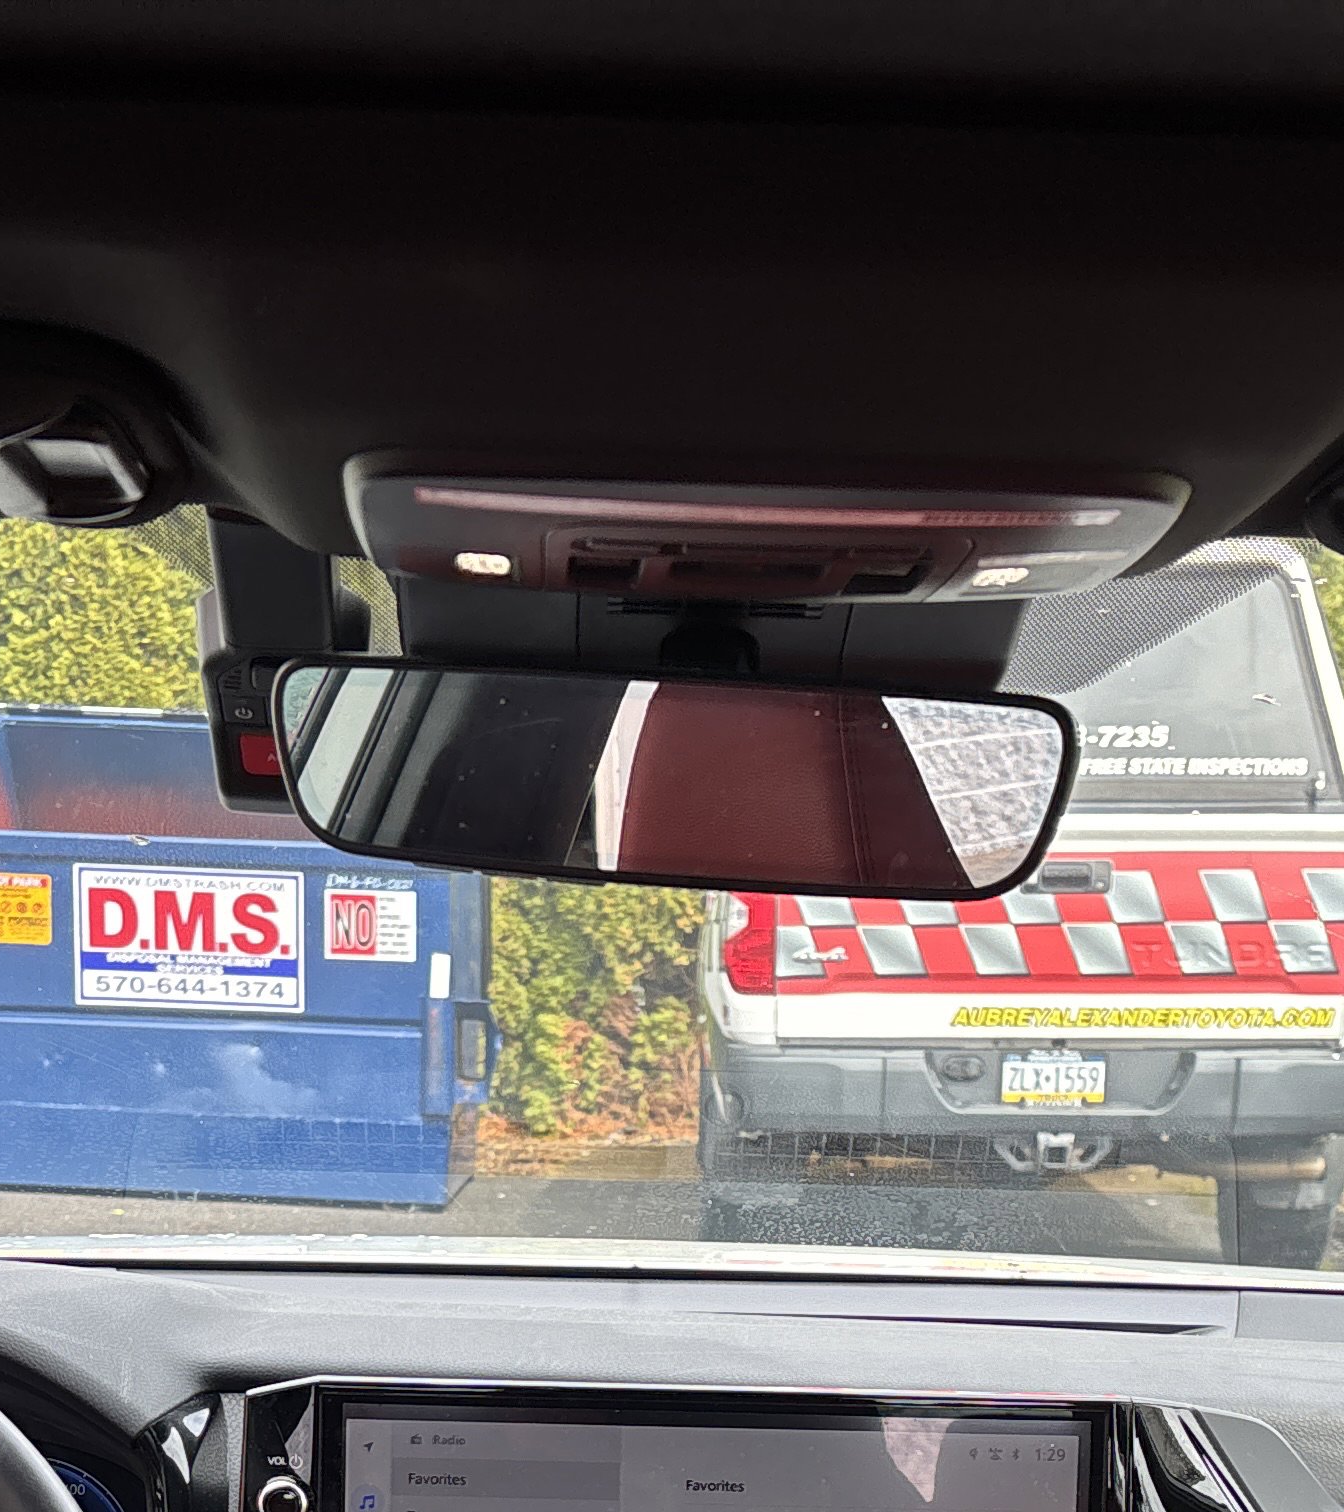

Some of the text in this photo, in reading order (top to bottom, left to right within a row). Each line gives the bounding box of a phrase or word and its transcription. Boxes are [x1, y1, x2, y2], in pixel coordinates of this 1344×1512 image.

[1128, 757, 1187, 776] STATE
[1187, 757, 1308, 776] INSPECTIONS
[88, 887, 290, 955] D.M.S.
[332, 899, 376, 951] NO
[96, 975, 284, 999] 570-644-1374
[950, 1006, 1335, 1030] AUBREYALEXANDERTOYOTA.COM
[432, 1435, 466, 1446] Radio
[1036, 1448, 1065, 1461] 1:29
[408, 1472, 467, 1487] Favorites
[686, 1479, 745, 1493] Favorites
[66, 1484, 86, 1495] 00
